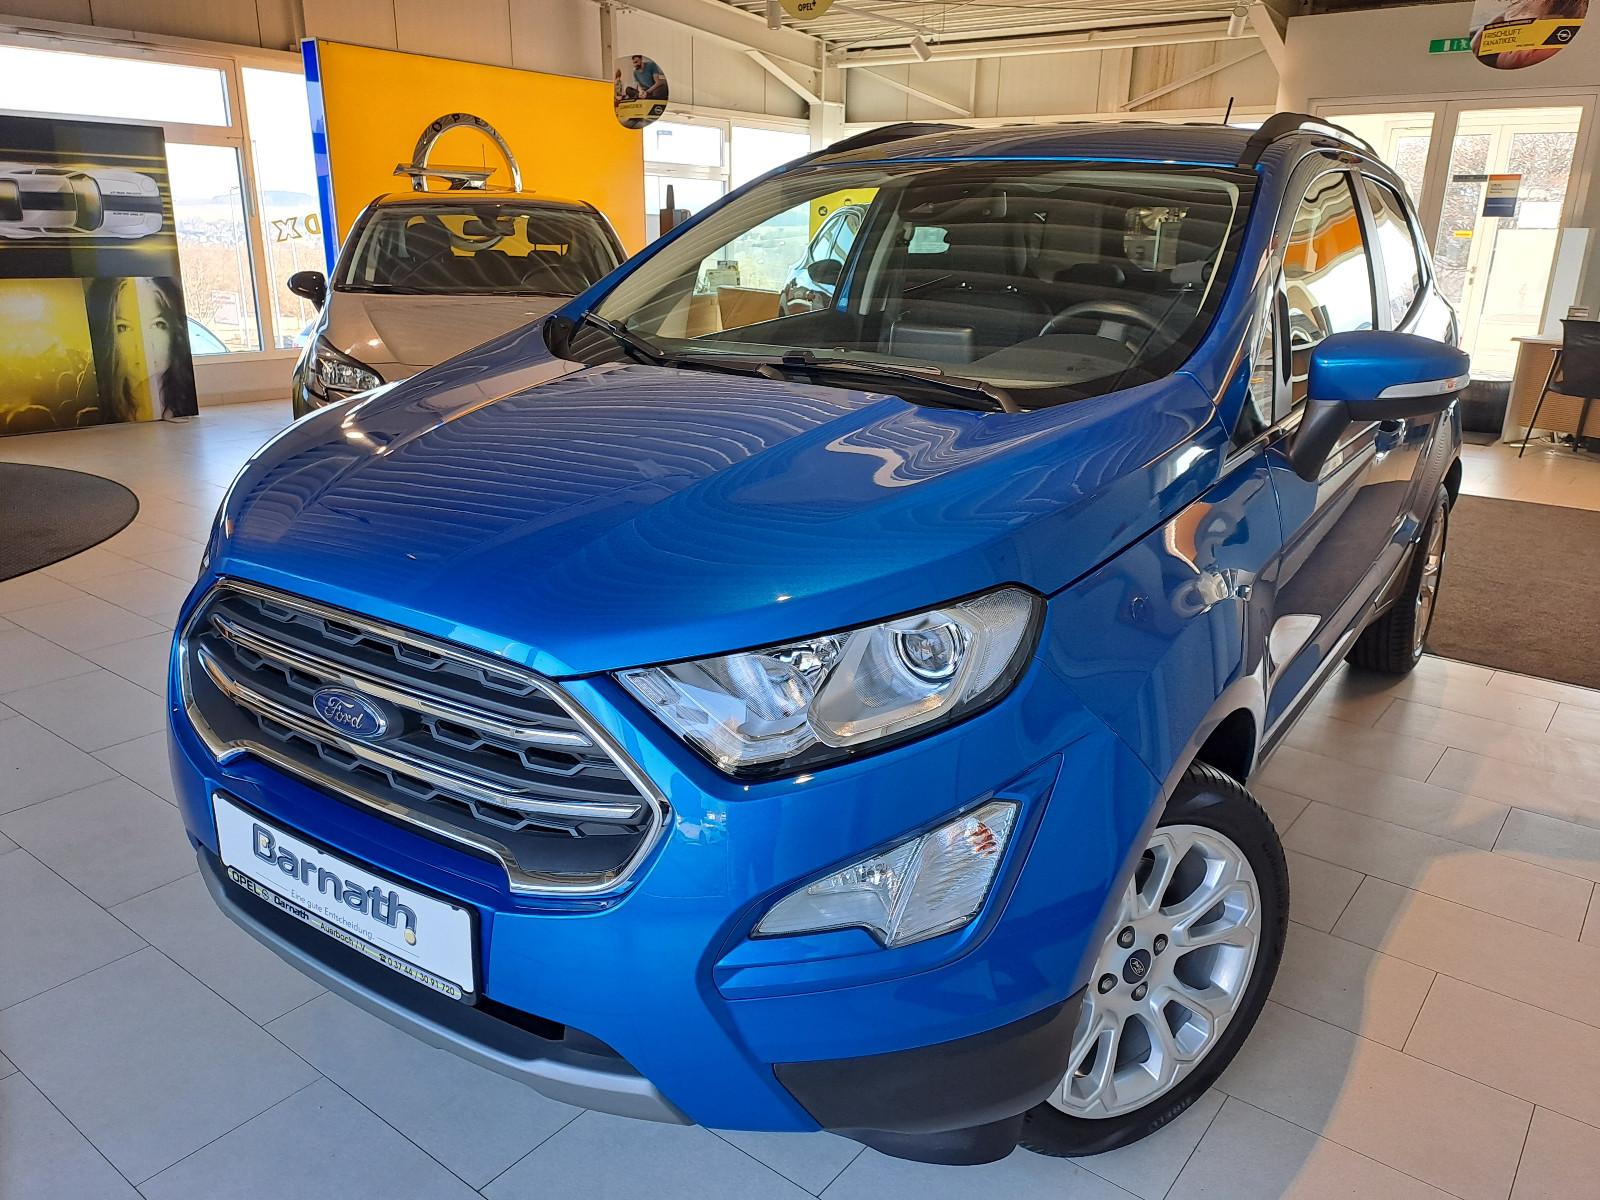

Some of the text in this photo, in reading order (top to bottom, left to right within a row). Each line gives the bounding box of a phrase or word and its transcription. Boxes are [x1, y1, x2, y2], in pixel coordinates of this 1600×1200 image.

[324, 696, 364, 729] Ford
[232, 870, 261, 896] OPEL
[252, 822, 418, 946] Barnath
[291, 888, 306, 904] Eine
[307, 900, 323, 913] gute
